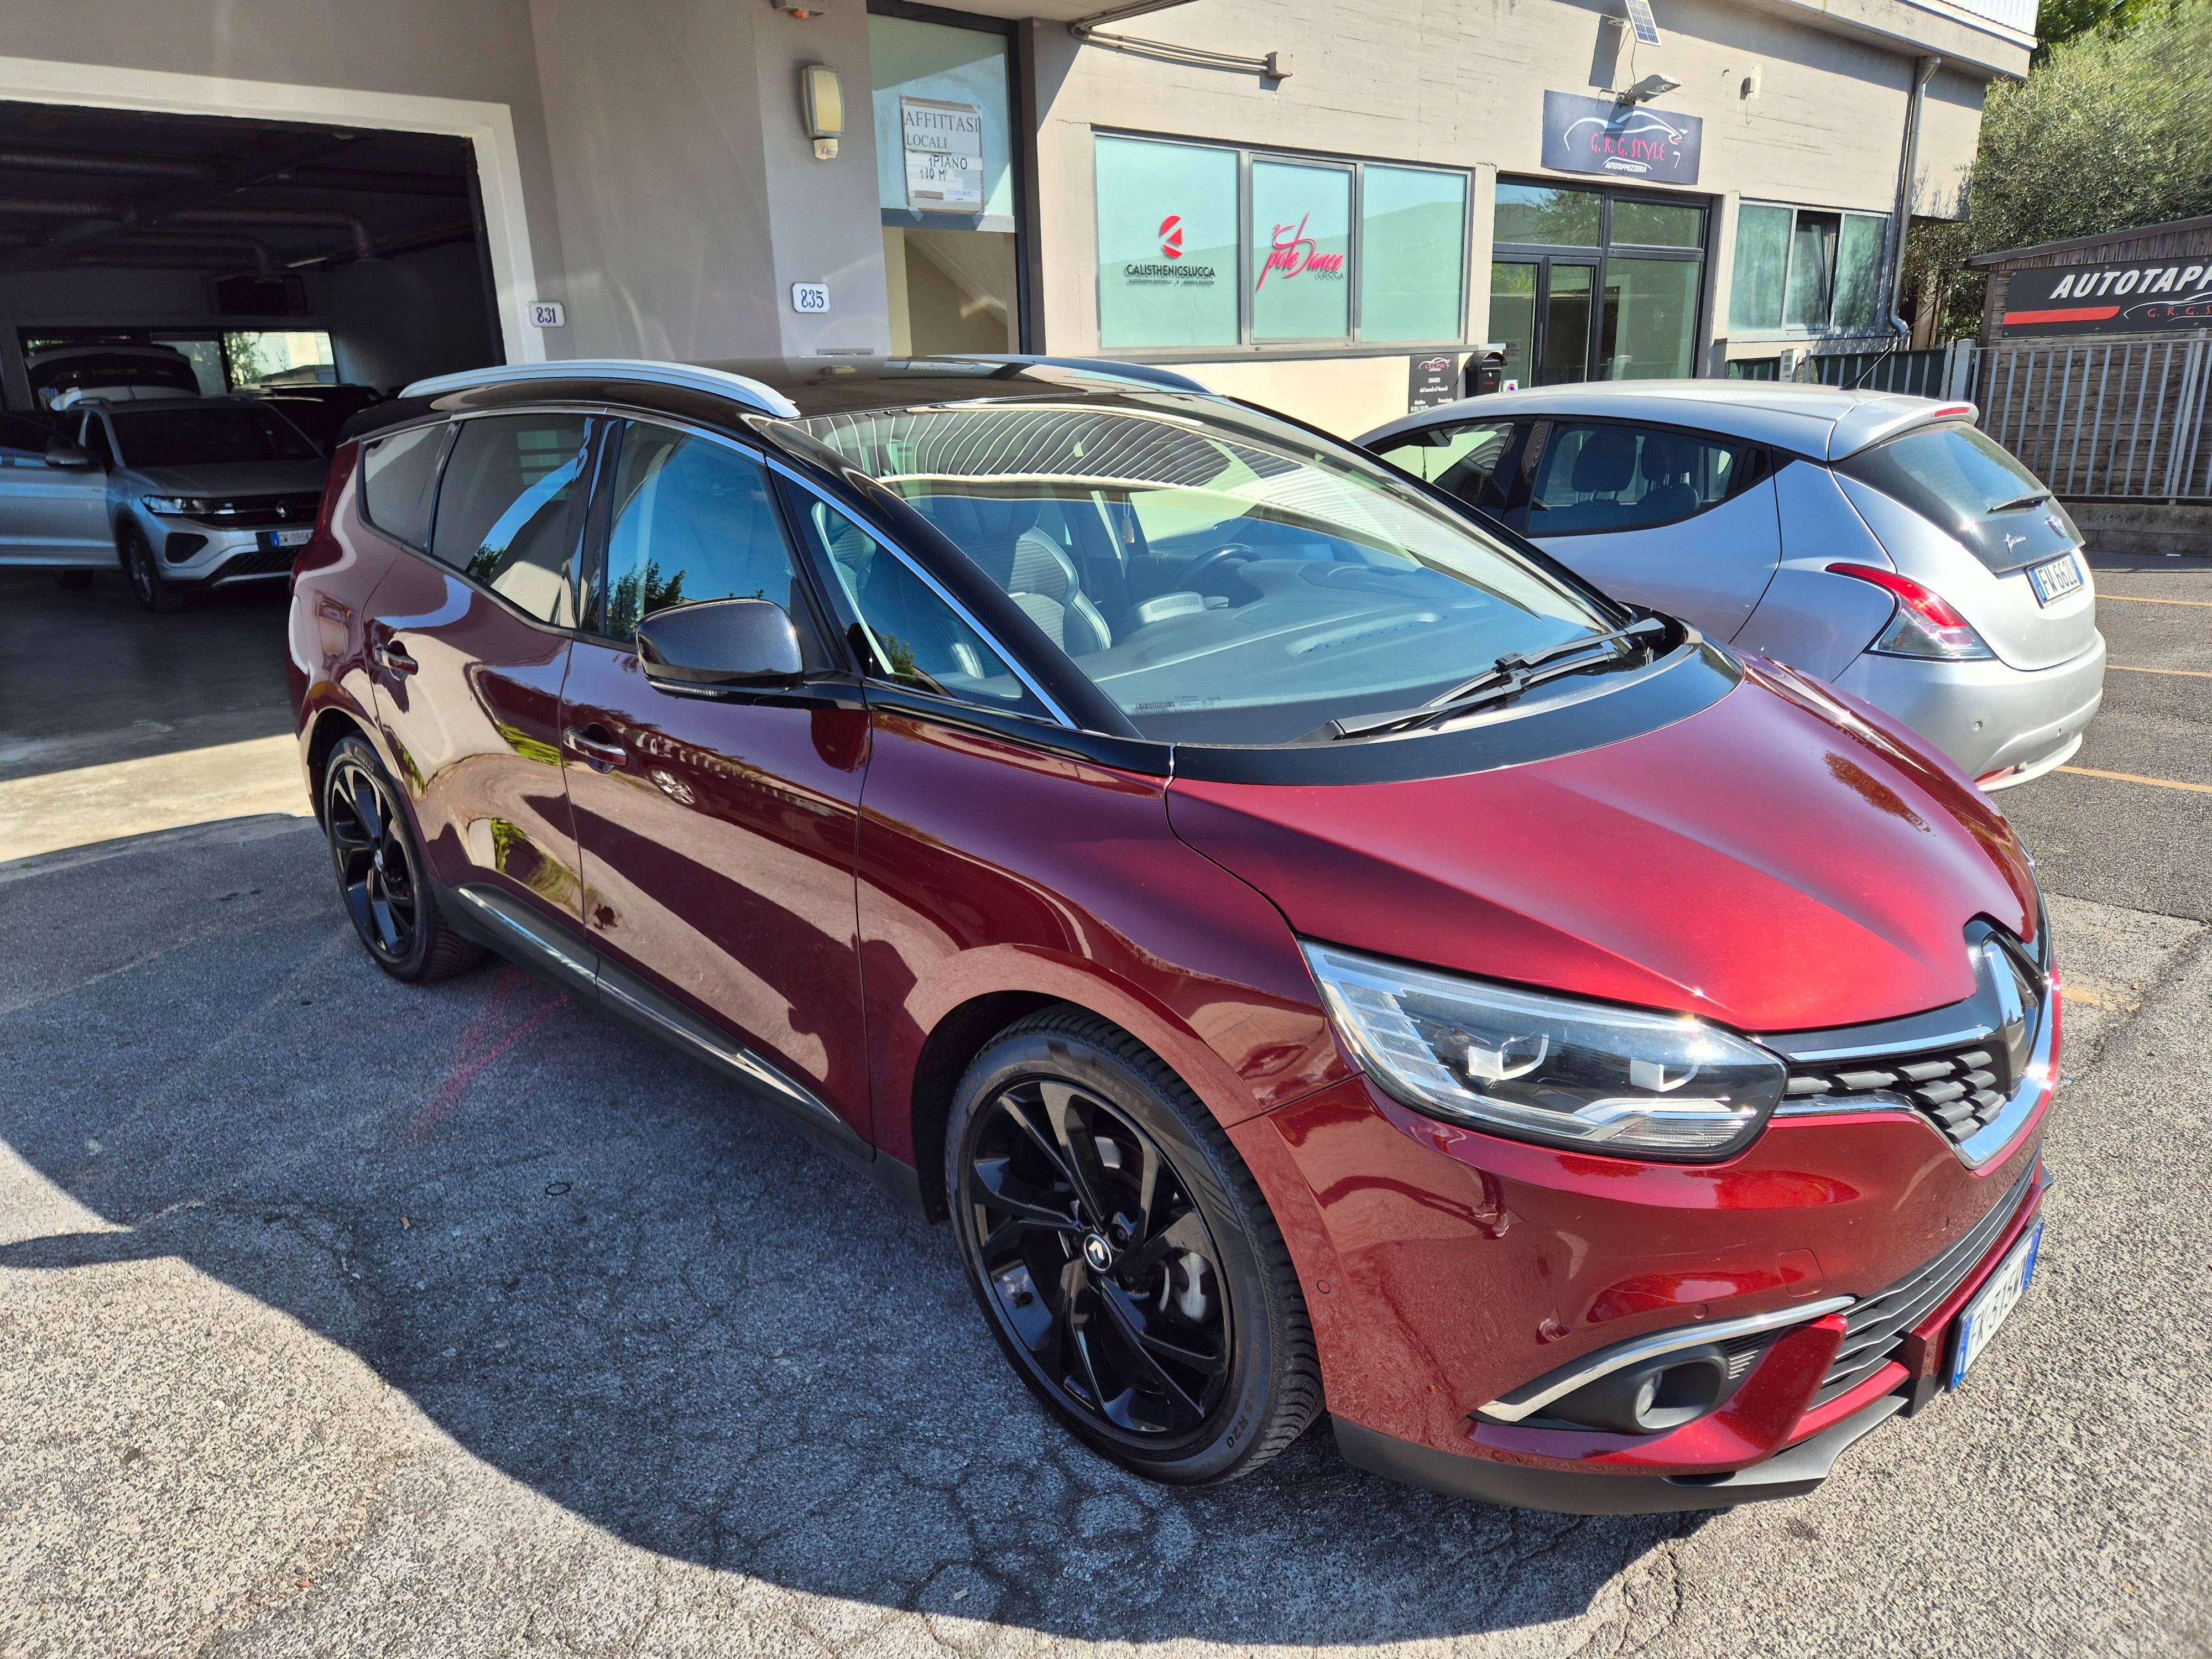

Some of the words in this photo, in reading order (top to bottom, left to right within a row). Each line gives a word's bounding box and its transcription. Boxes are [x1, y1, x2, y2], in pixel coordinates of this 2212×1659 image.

[905, 111, 979, 133] AFFITTASI
[906, 134, 947, 149] LOCALI
[1631, 139, 1665, 161] STYLE
[920, 168, 935, 179] 130
[1605, 161, 1647, 173] AUTOTAPPEZZERIA
[801, 289, 824, 308] 835
[536, 307, 557, 324] 831
